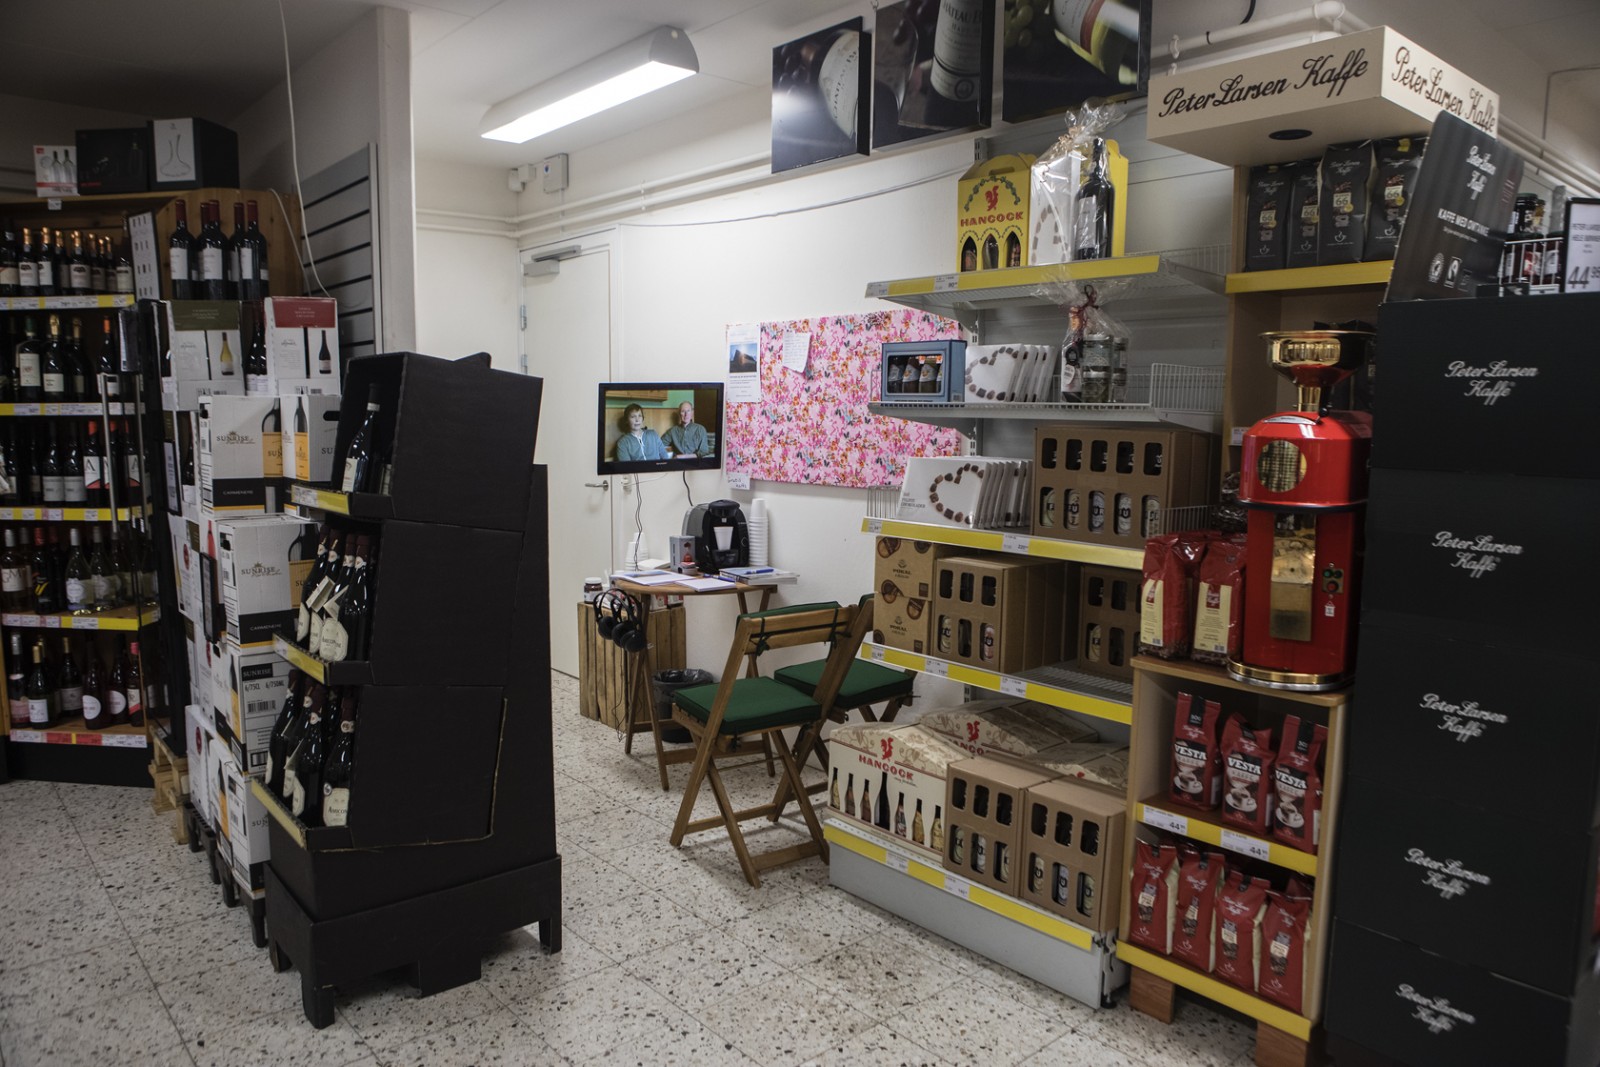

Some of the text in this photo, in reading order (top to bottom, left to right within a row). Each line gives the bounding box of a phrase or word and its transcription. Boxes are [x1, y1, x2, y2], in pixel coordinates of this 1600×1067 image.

[1158, 48, 1369, 118] Peter Larsen Kaffe
[1391, 46, 1428, 95] Peter
[1424, 67, 1464, 116] Larsen
[960, 211, 1024, 227] HANCOCK
[1437, 207, 1457, 224] KAFFE
[1455, 214, 1469, 228] MED
[1567, 266, 1590, 289] 44
[1444, 359, 1539, 378] Peter Larsen
[1463, 379, 1512, 406] Kaffe
[1431, 530, 1524, 555] Peter Larsen
[1449, 551, 1498, 578] Kaffe
[1419, 692, 1509, 724] Peter Larsen
[1436, 714, 1483, 743] Kaffe
[1174, 743, 1208, 761] VESTA
[858, 754, 914, 781] HANCOCK
[1227, 756, 1262, 775] VESTA
[1275, 769, 1308, 789] VESTA
[1169, 821, 1181, 830] 44
[1249, 846, 1261, 856] 44
[1404, 847, 1445, 870] Peter
